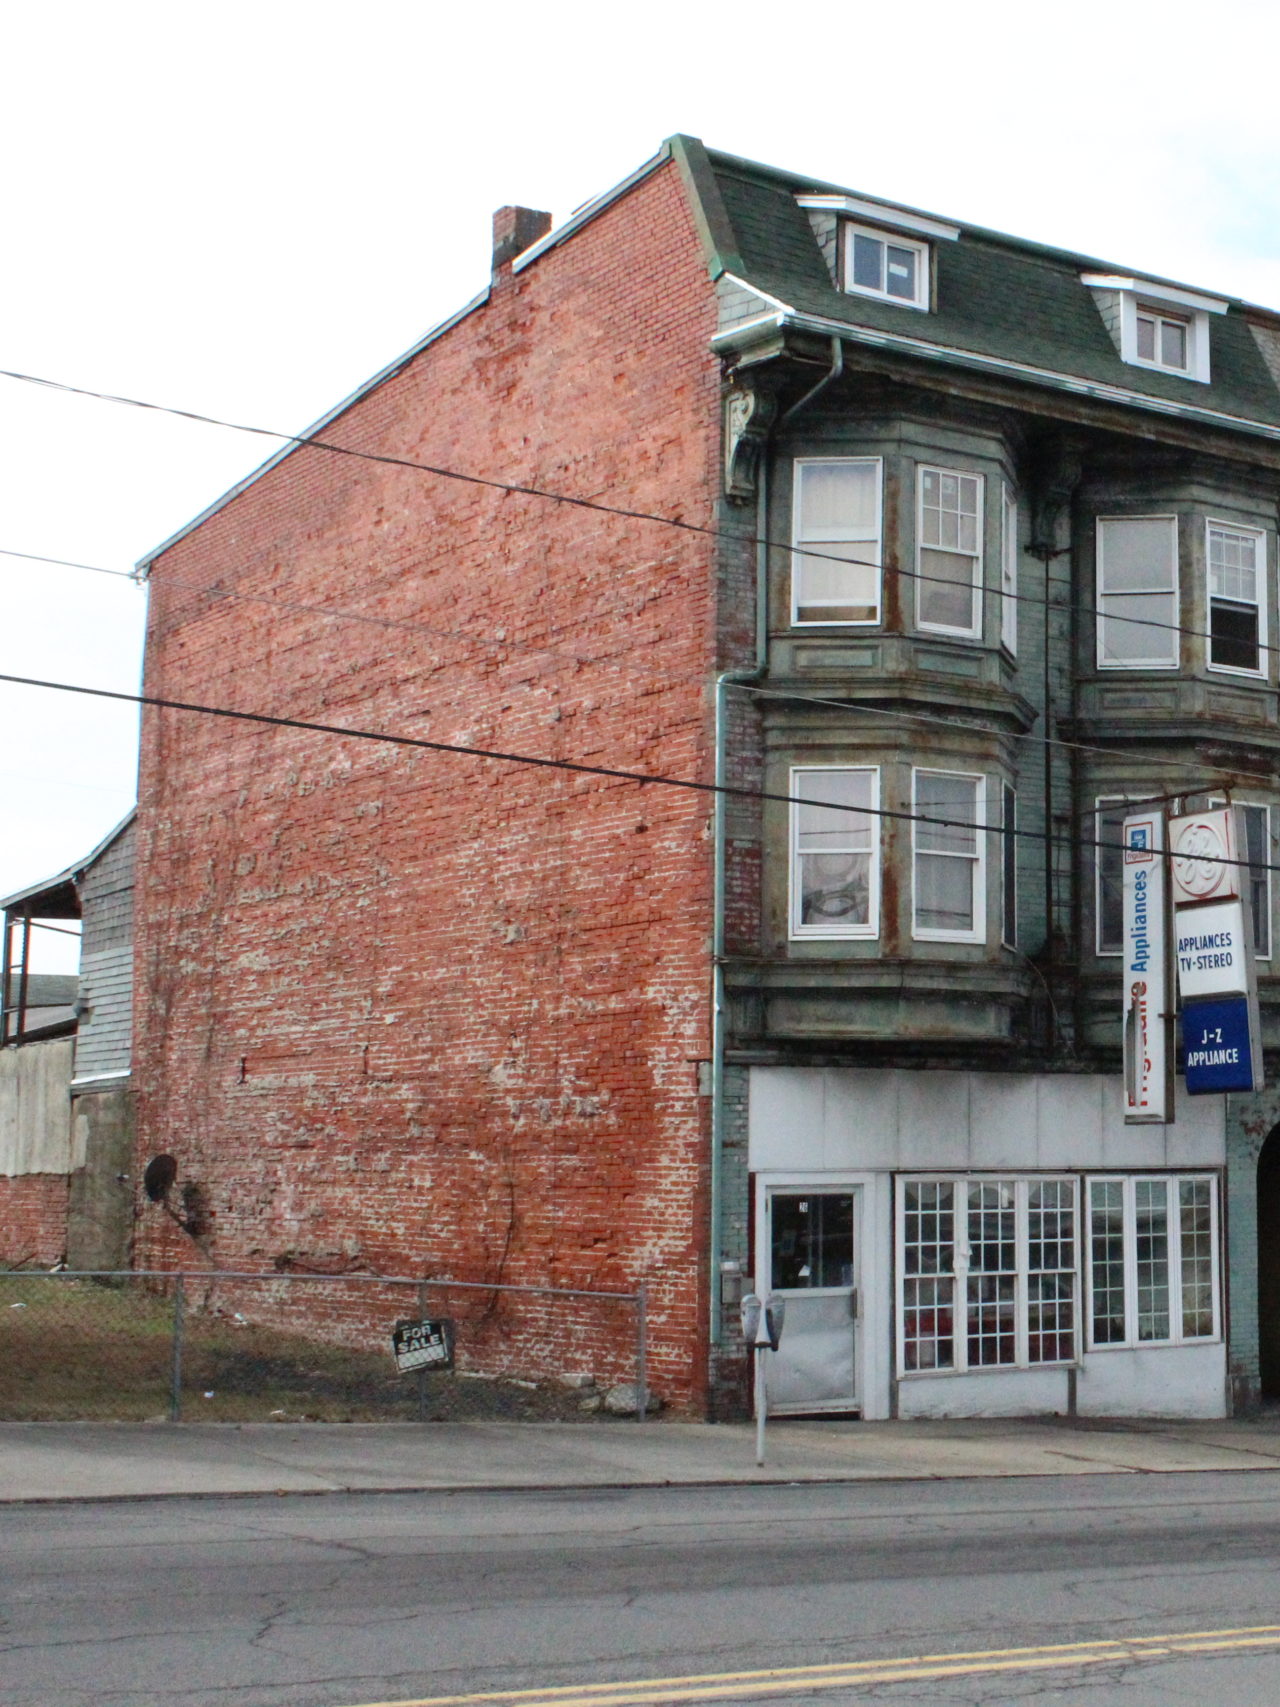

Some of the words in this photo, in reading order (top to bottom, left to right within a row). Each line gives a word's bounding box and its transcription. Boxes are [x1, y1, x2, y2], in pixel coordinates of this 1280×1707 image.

[1130, 870, 1150, 972] Appliances
[1179, 932, 1232, 952] APPLIANCES
[1180, 952, 1232, 972] TV-STEREO
[1201, 1028, 1222, 1044] J-Z
[1188, 1048, 1239, 1067] APPLIANCE
[402, 1325, 431, 1341] FOR
[397, 1334, 440, 1353] SALE
